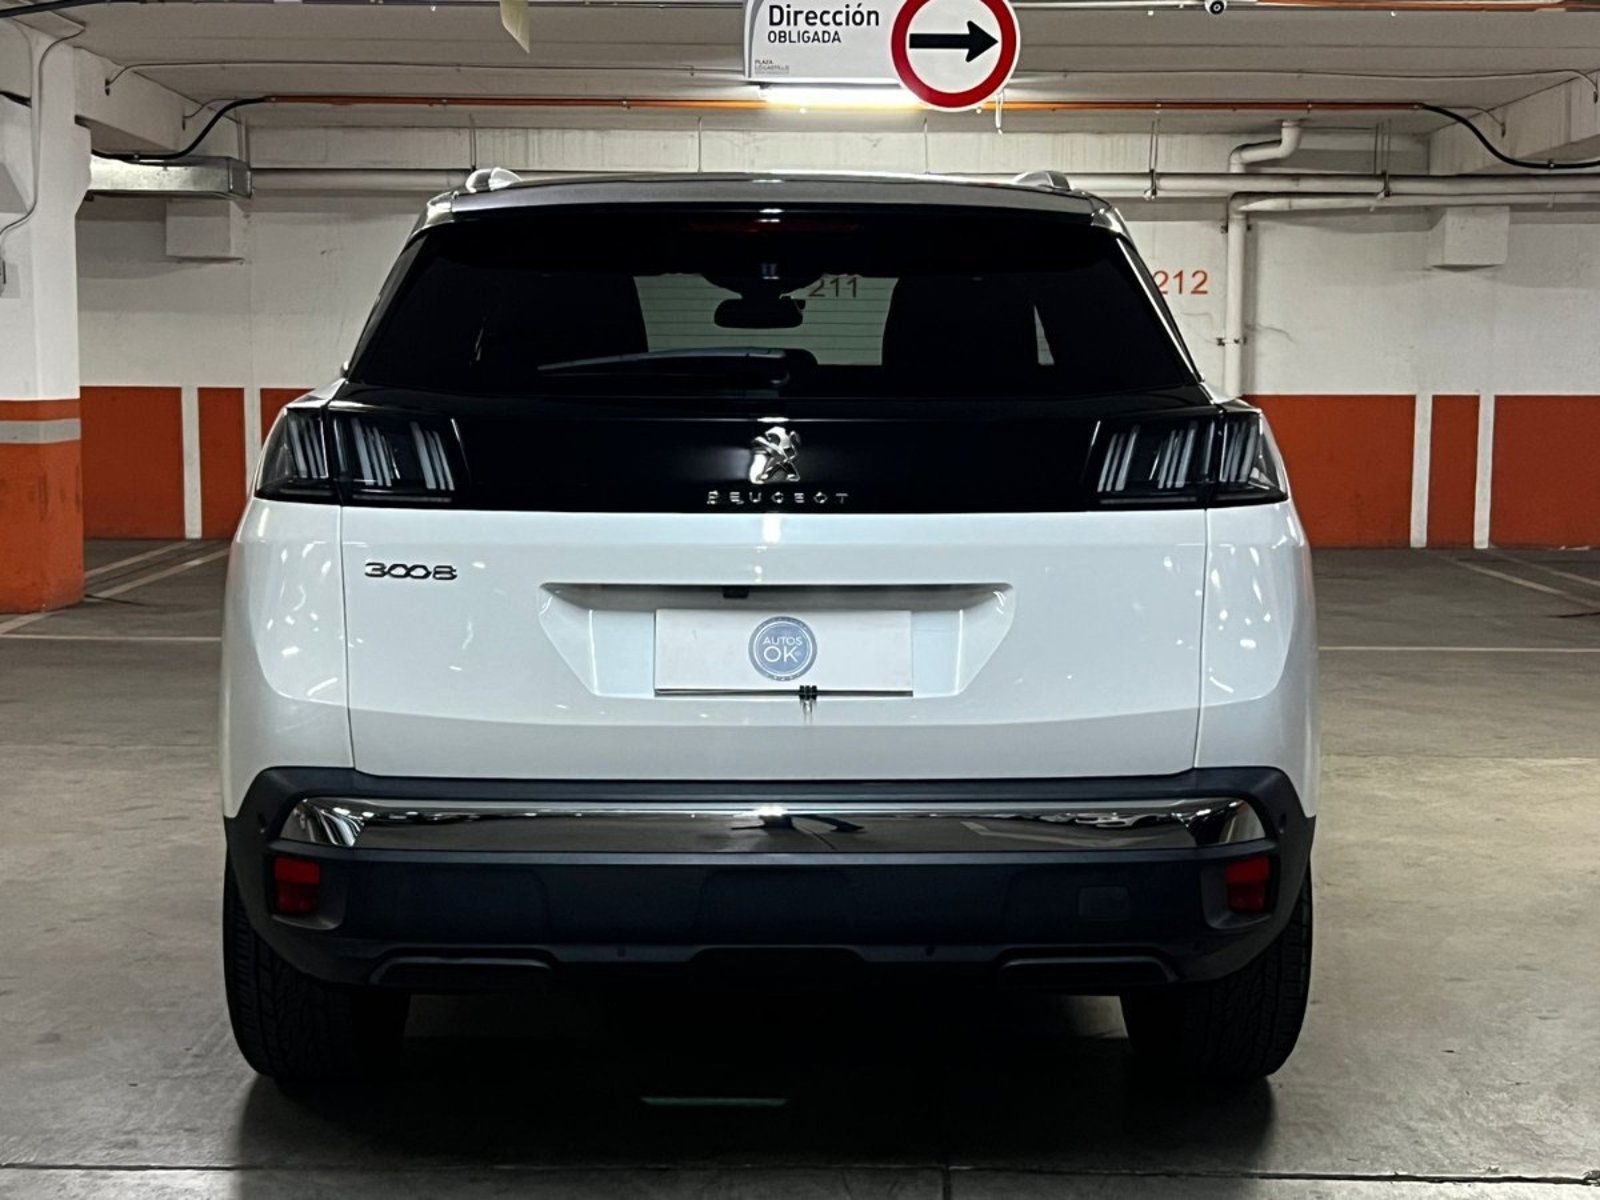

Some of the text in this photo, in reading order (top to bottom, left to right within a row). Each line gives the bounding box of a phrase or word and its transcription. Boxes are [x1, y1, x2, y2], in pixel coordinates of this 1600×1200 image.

[768, 1, 880, 26] Dirección
[767, 30, 842, 44] OBLIGADA
[808, 277, 858, 297] 211
[1152, 270, 1208, 294] 212
[706, 490, 849, 505] PEUGEOT
[364, 562, 458, 581] 3008
[762, 636, 803, 646] AUTOS
[763, 645, 799, 663] OK
